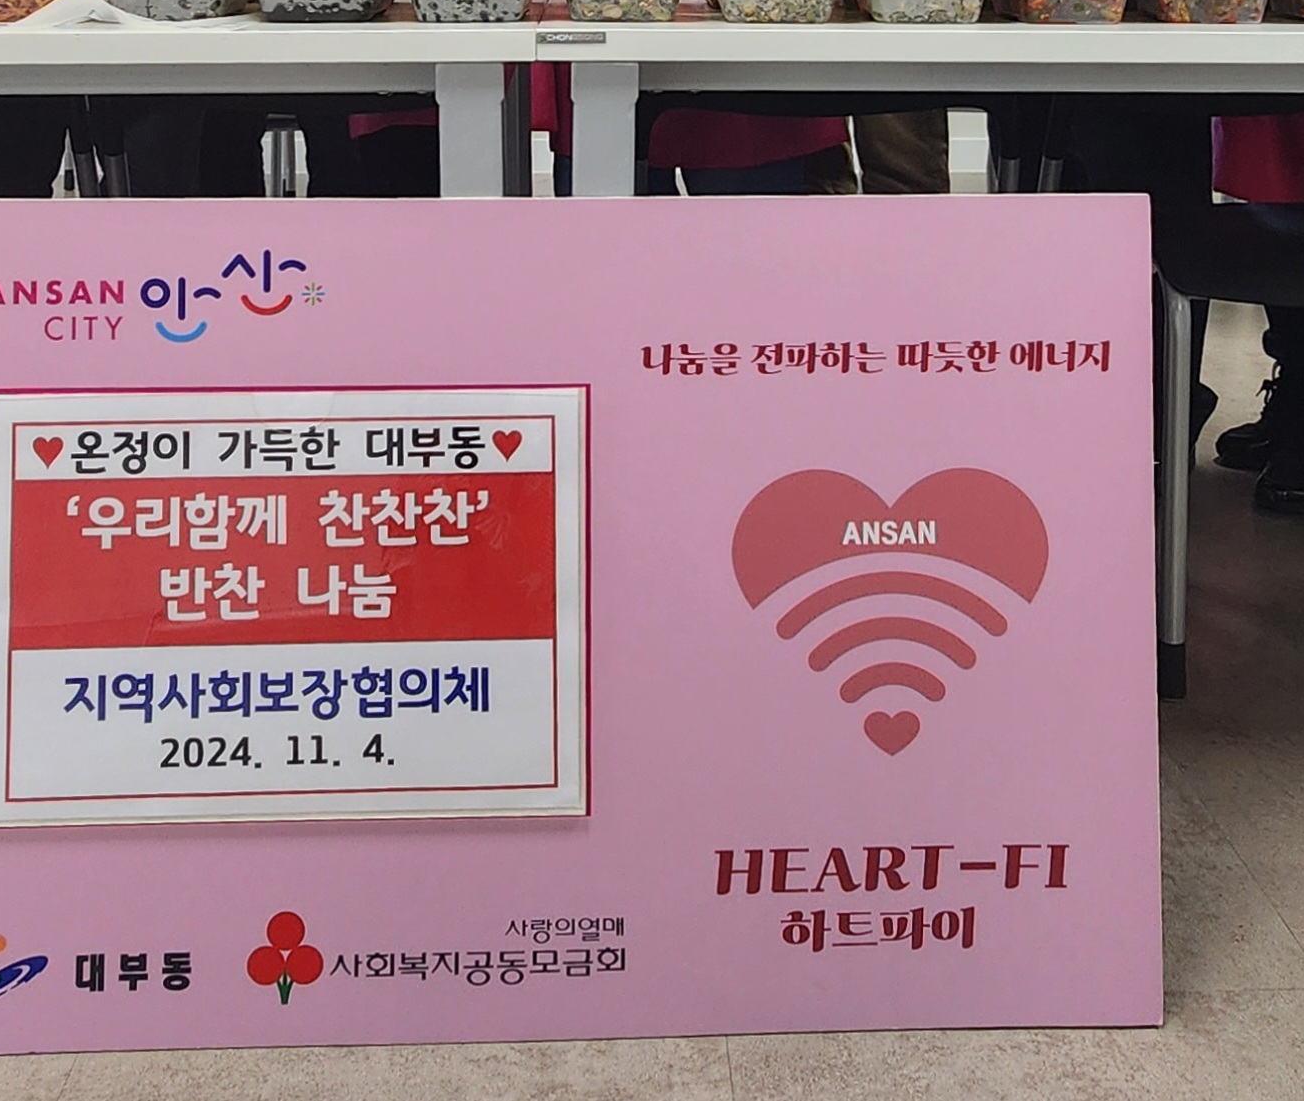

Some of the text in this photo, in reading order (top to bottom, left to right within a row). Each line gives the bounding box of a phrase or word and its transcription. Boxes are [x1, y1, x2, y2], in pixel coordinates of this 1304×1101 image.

[44, 316, 123, 340] CITY
[641, 340, 1111, 376] 나눔을 전파하는 따듯한 에너지
[71, 425, 486, 474] 온정이 가득한 대부동
[843, 521, 936, 546] ANSAN
[160, 563, 397, 622] 반찬 나눔
[63, 666, 490, 724] 지역사회보장협의체
[160, 734, 395, 769] 2024. 11. 4.
[715, 845, 1070, 896] HEART-FI
[505, 916, 626, 941] 사랑의열매
[780, 906, 976, 953] 하트파이
[75, 951, 192, 993] 대부동
[329, 946, 627, 987] 사회복지공동모금회
